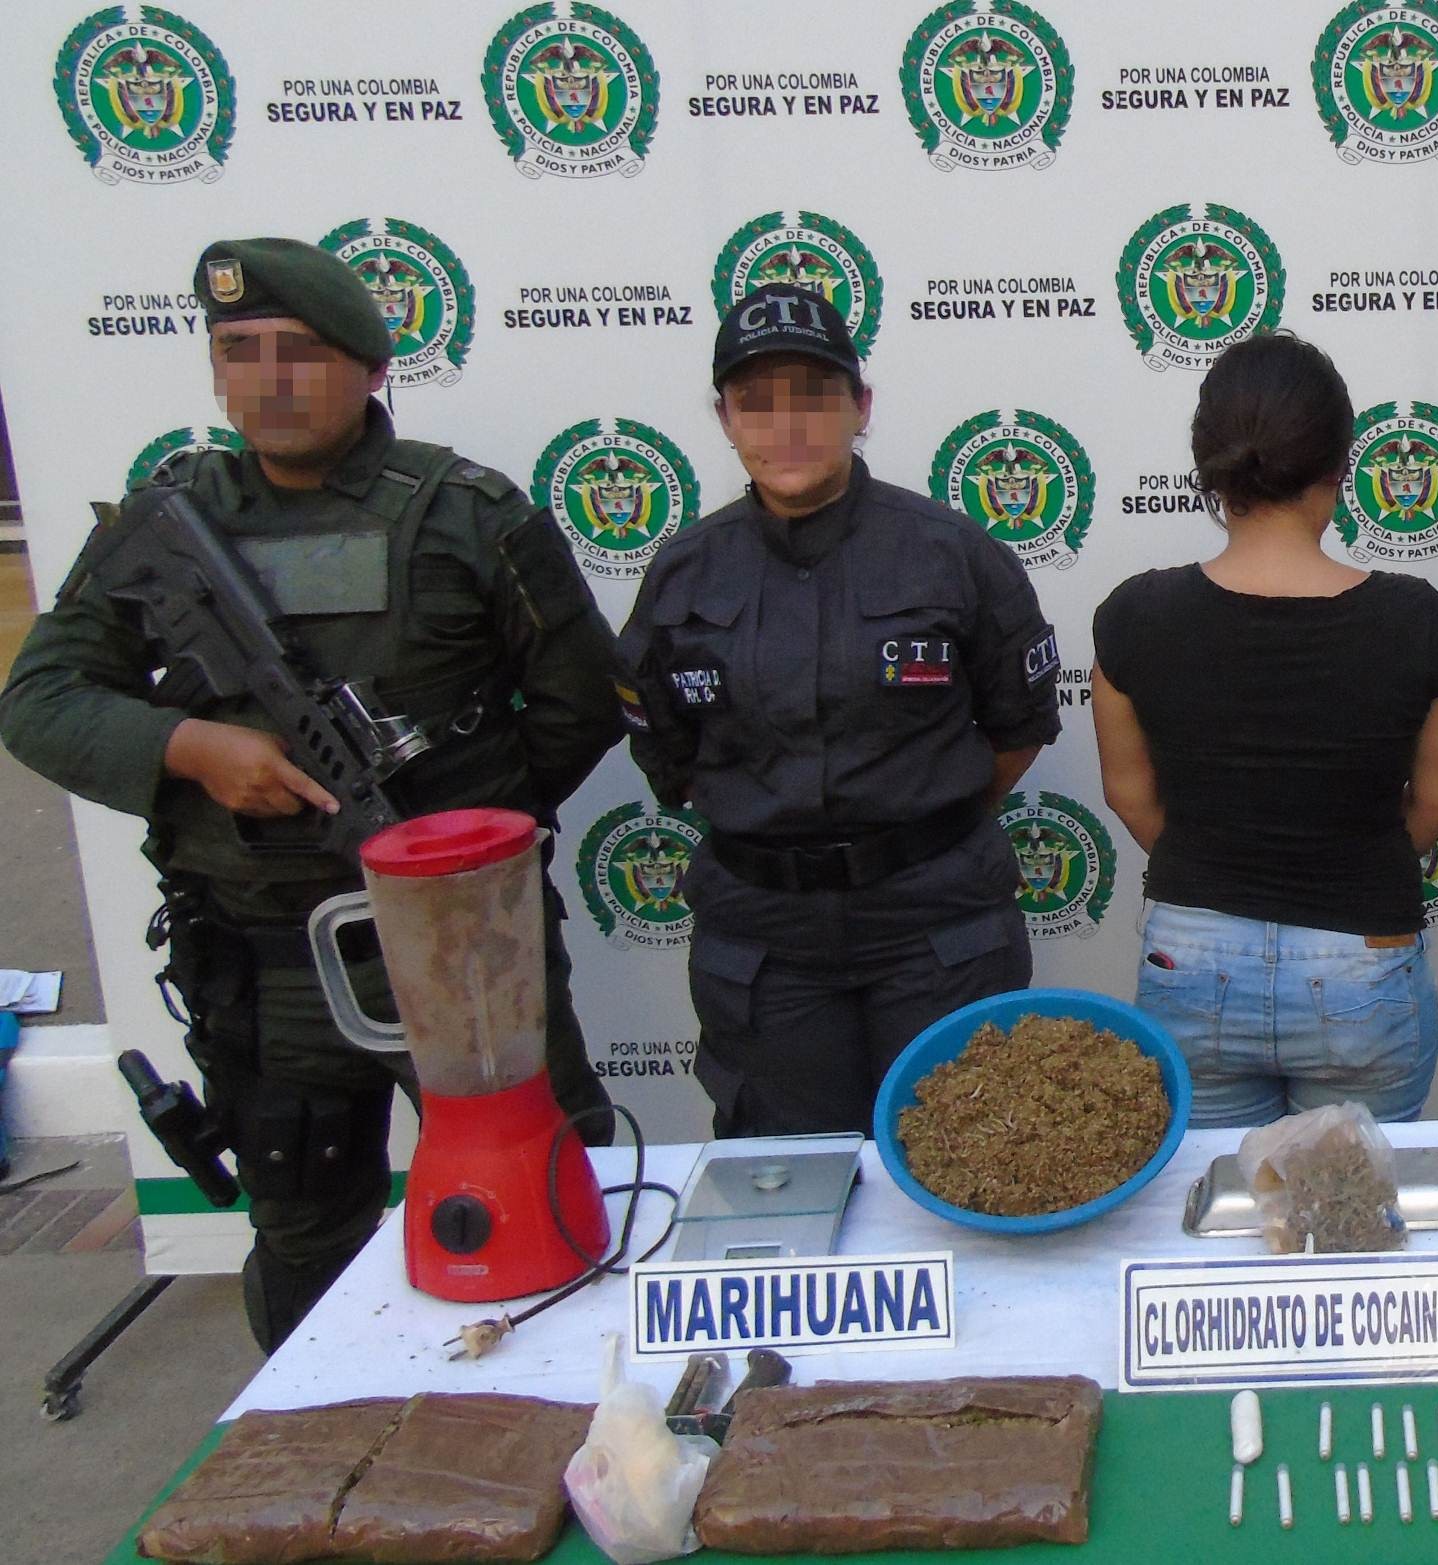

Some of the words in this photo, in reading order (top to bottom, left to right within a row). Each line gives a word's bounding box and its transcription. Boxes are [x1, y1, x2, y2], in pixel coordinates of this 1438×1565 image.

[129, 26, 148, 36] DE
[164, 34, 215, 105] COLOMBIA
[1120, 68, 1151, 84] POR
[1156, 68, 1186, 84] UNA
[1191, 67, 1270, 83] COLOMBIA
[284, 80, 316, 96] POR
[320, 79, 353, 96] UNA
[357, 79, 440, 96] COLOMBIA
[1102, 90, 1188, 110] SEGURA
[1194, 89, 1208, 108] Y
[1216, 89, 1243, 108] EN
[1251, 88, 1290, 107] PAZ
[267, 102, 358, 122] SEGURA
[363, 102, 376, 121] Y
[385, 102, 414, 121] EN
[421, 101, 462, 120] PAZ
[156, 122, 213, 162] NACIONAL
[112, 161, 145, 179] DIOS
[160, 159, 204, 180] PATRIA
[520, 287, 551, 304] POR
[556, 287, 588, 303] UNA
[591, 285, 671, 302] COLOMBIA
[928, 280, 959, 295] POR
[964, 279, 993, 295] UNA
[998, 278, 1076, 294] COLOMBIA
[104, 294, 136, 311] POR
[139, 294, 173, 310] UNA
[739, 294, 828, 331] CTI
[911, 300, 996, 320] SEGURA
[1002, 300, 1015, 318] Y
[1023, 299, 1050, 317] EN
[1058, 298, 1096, 317] PAZ
[88, 316, 178, 336] SEGURA
[182, 316, 196, 334] Y
[504, 309, 591, 328] SEGURA
[596, 308, 610, 326] Y
[618, 307, 646, 326] EN
[653, 306, 693, 325] PAZ
[782, 325, 830, 342] JUDICIAL
[1344, 427, 1385, 492] REUBLICA
[1397, 419, 1415, 429] DE
[1140, 475, 1169, 490] POR
[1121, 496, 1203, 514] SEGURA
[1366, 541, 1395, 558] DIOS
[1025, 635, 1058, 675] CTI
[611, 1042, 639, 1056] POR
[643, 1041, 671, 1055] UNA
[595, 1060, 675, 1077] SEGURA
[680, 1058, 692, 1075] Y
[646, 1268, 940, 1343] MARIHUANA
[1144, 1294, 1307, 1357] CLORHIDRATO
[1315, 1293, 1344, 1347] DE
